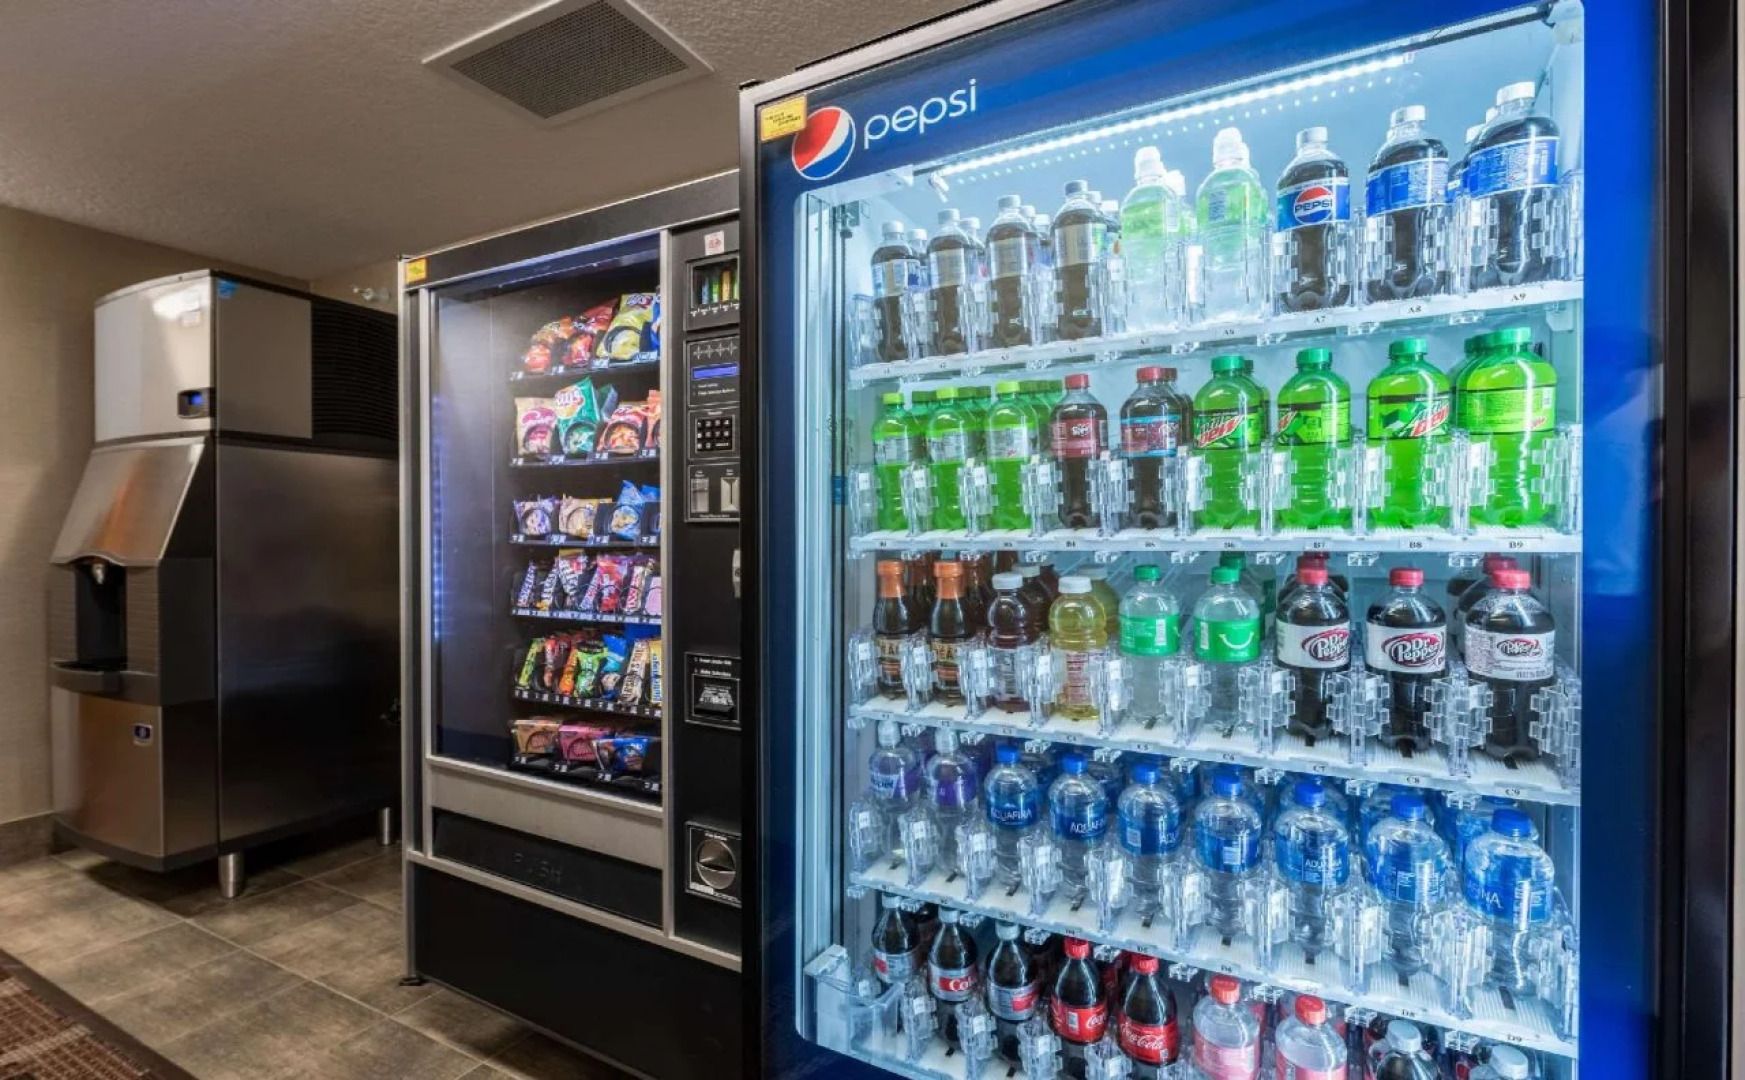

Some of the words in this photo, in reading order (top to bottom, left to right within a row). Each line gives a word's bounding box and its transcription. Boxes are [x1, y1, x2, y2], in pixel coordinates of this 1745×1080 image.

[864, 78, 977, 150] pepsi
[1295, 199, 1333, 213] PEPSI
[1511, 292, 1527, 301] A9
[1407, 305, 1422, 313] A8
[1508, 541, 1523, 549] B9
[1313, 764, 1326, 772] C7
[1406, 775, 1420, 784] C8
[1504, 788, 1520, 796] C9
[990, 807, 1033, 822] AQUAFINA
